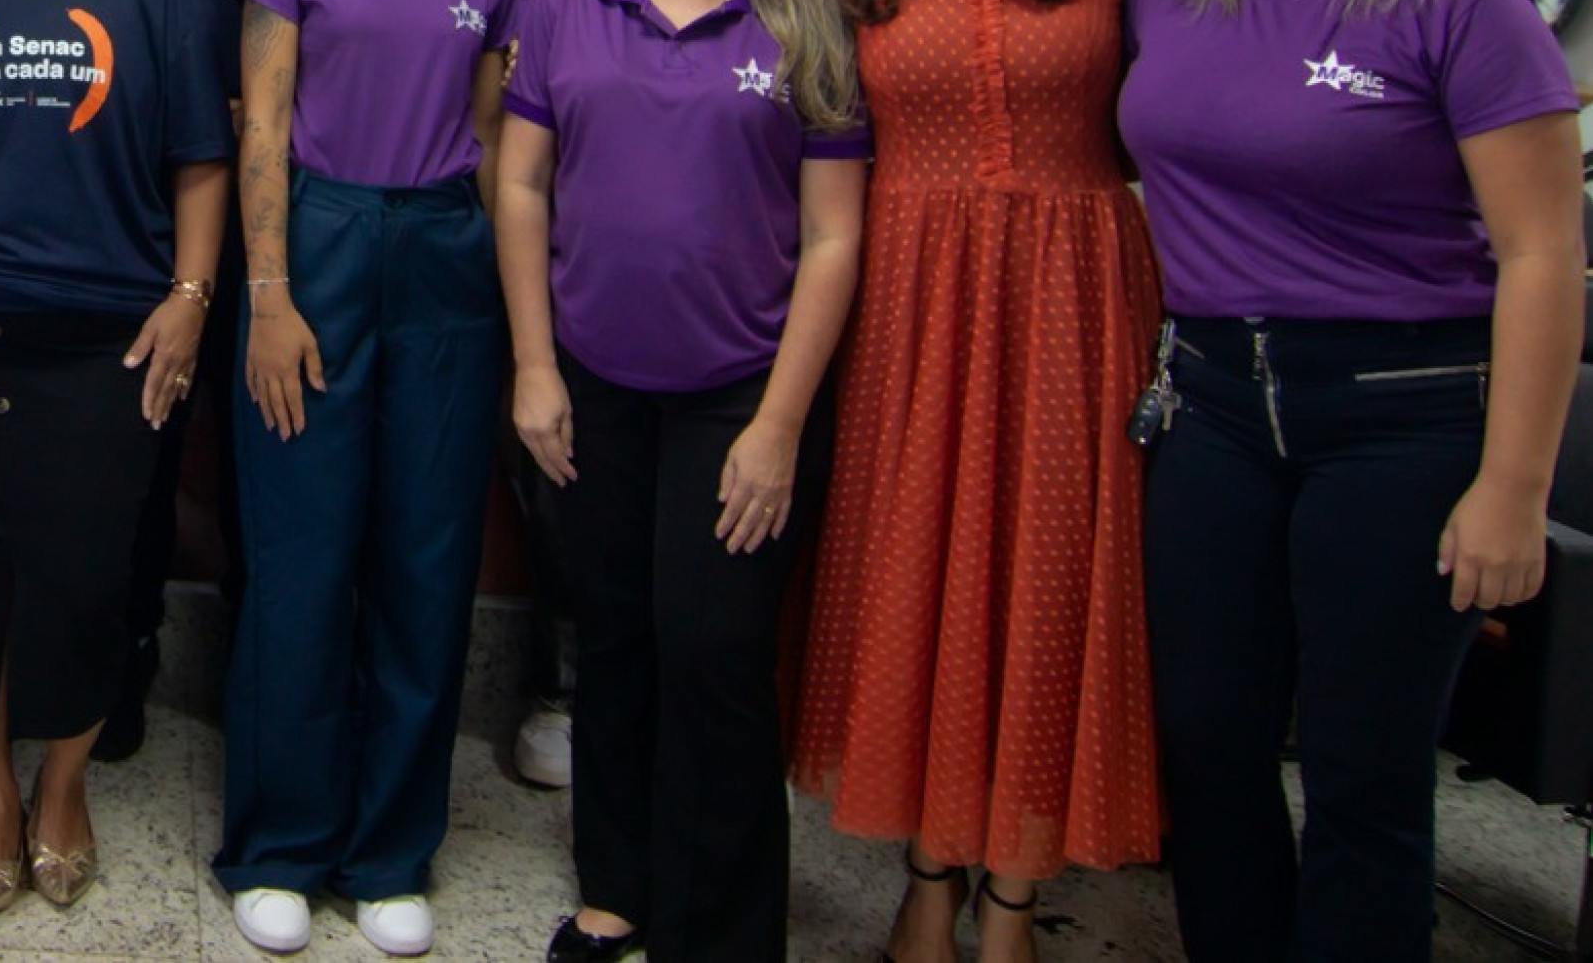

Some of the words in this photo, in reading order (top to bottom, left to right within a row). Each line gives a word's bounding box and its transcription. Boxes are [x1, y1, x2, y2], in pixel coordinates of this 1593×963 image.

[8, 35, 85, 57] Senac
[5, 59, 64, 80] cada
[70, 64, 106, 85] um
